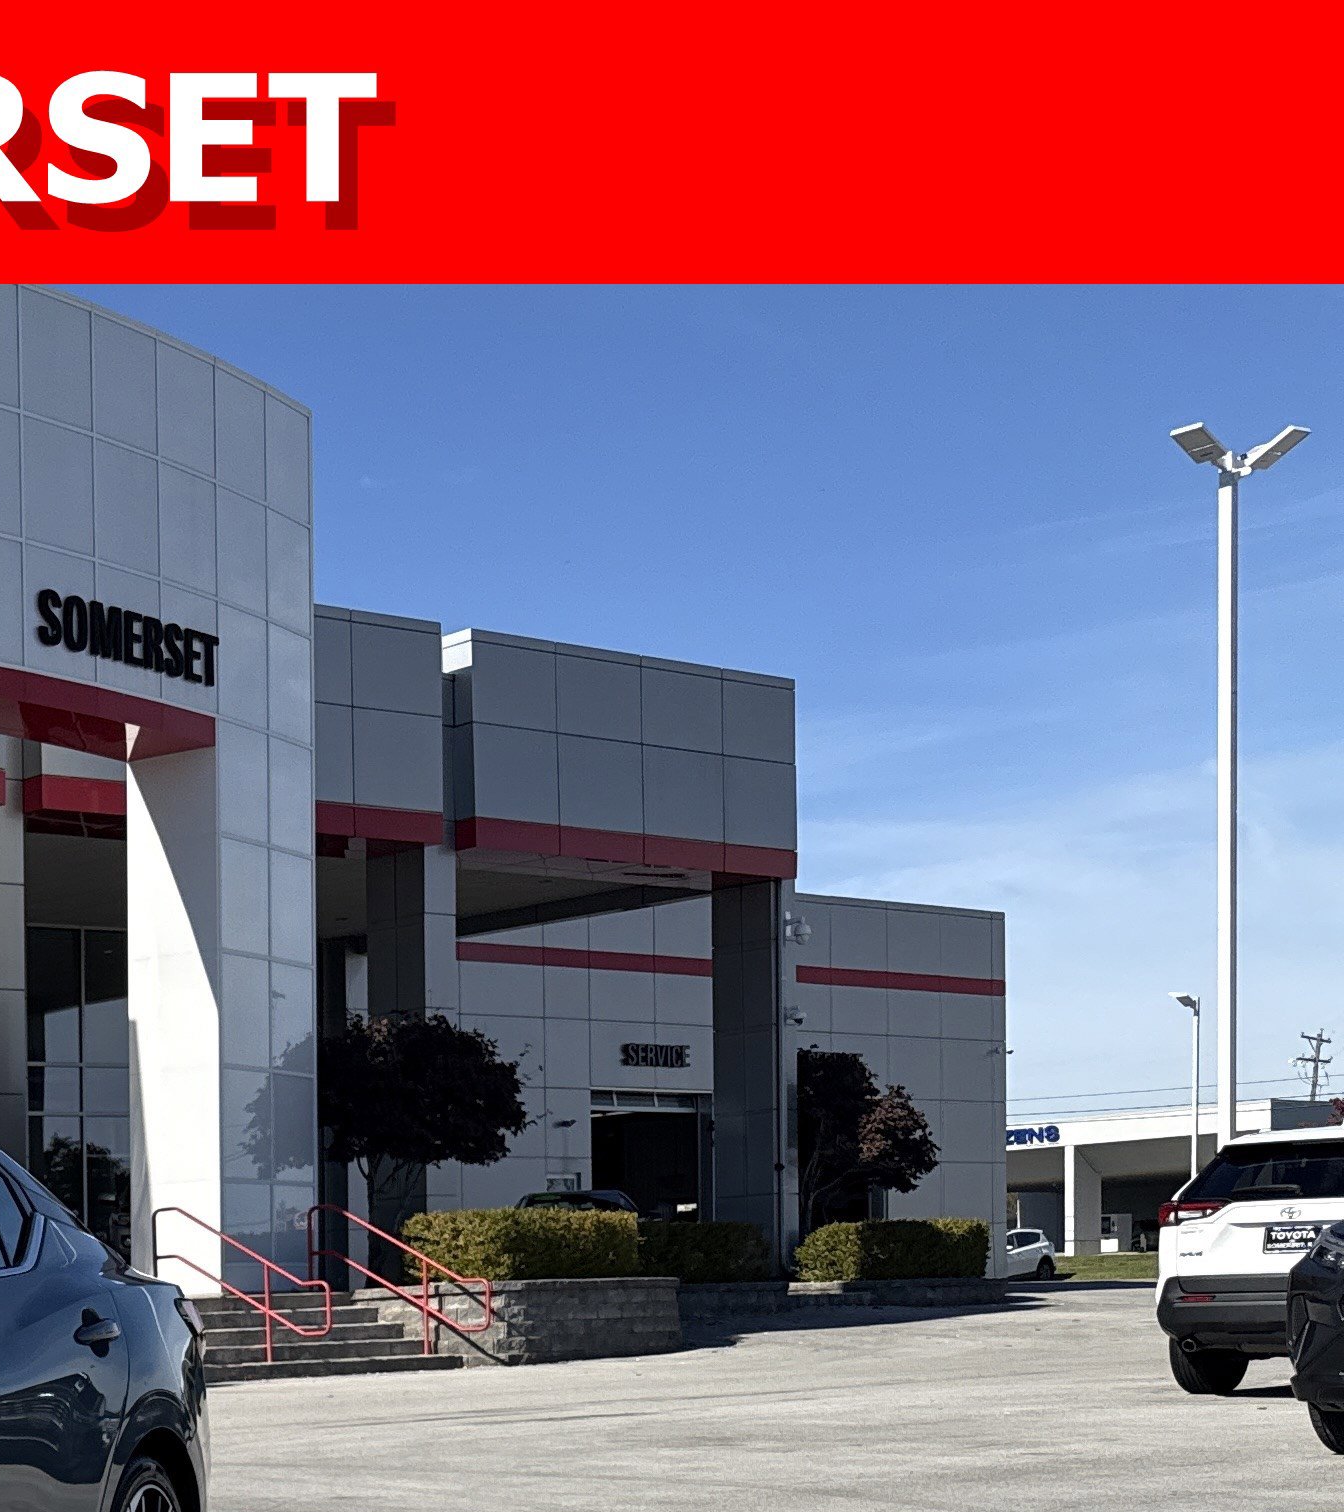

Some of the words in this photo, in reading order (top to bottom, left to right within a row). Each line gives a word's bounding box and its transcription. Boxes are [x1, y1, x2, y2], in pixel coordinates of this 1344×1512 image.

[37, 588, 220, 687] SOMERSET
[622, 1043, 691, 1068] SERVICE
[1270, 1230, 1317, 1240] TOYOTA
